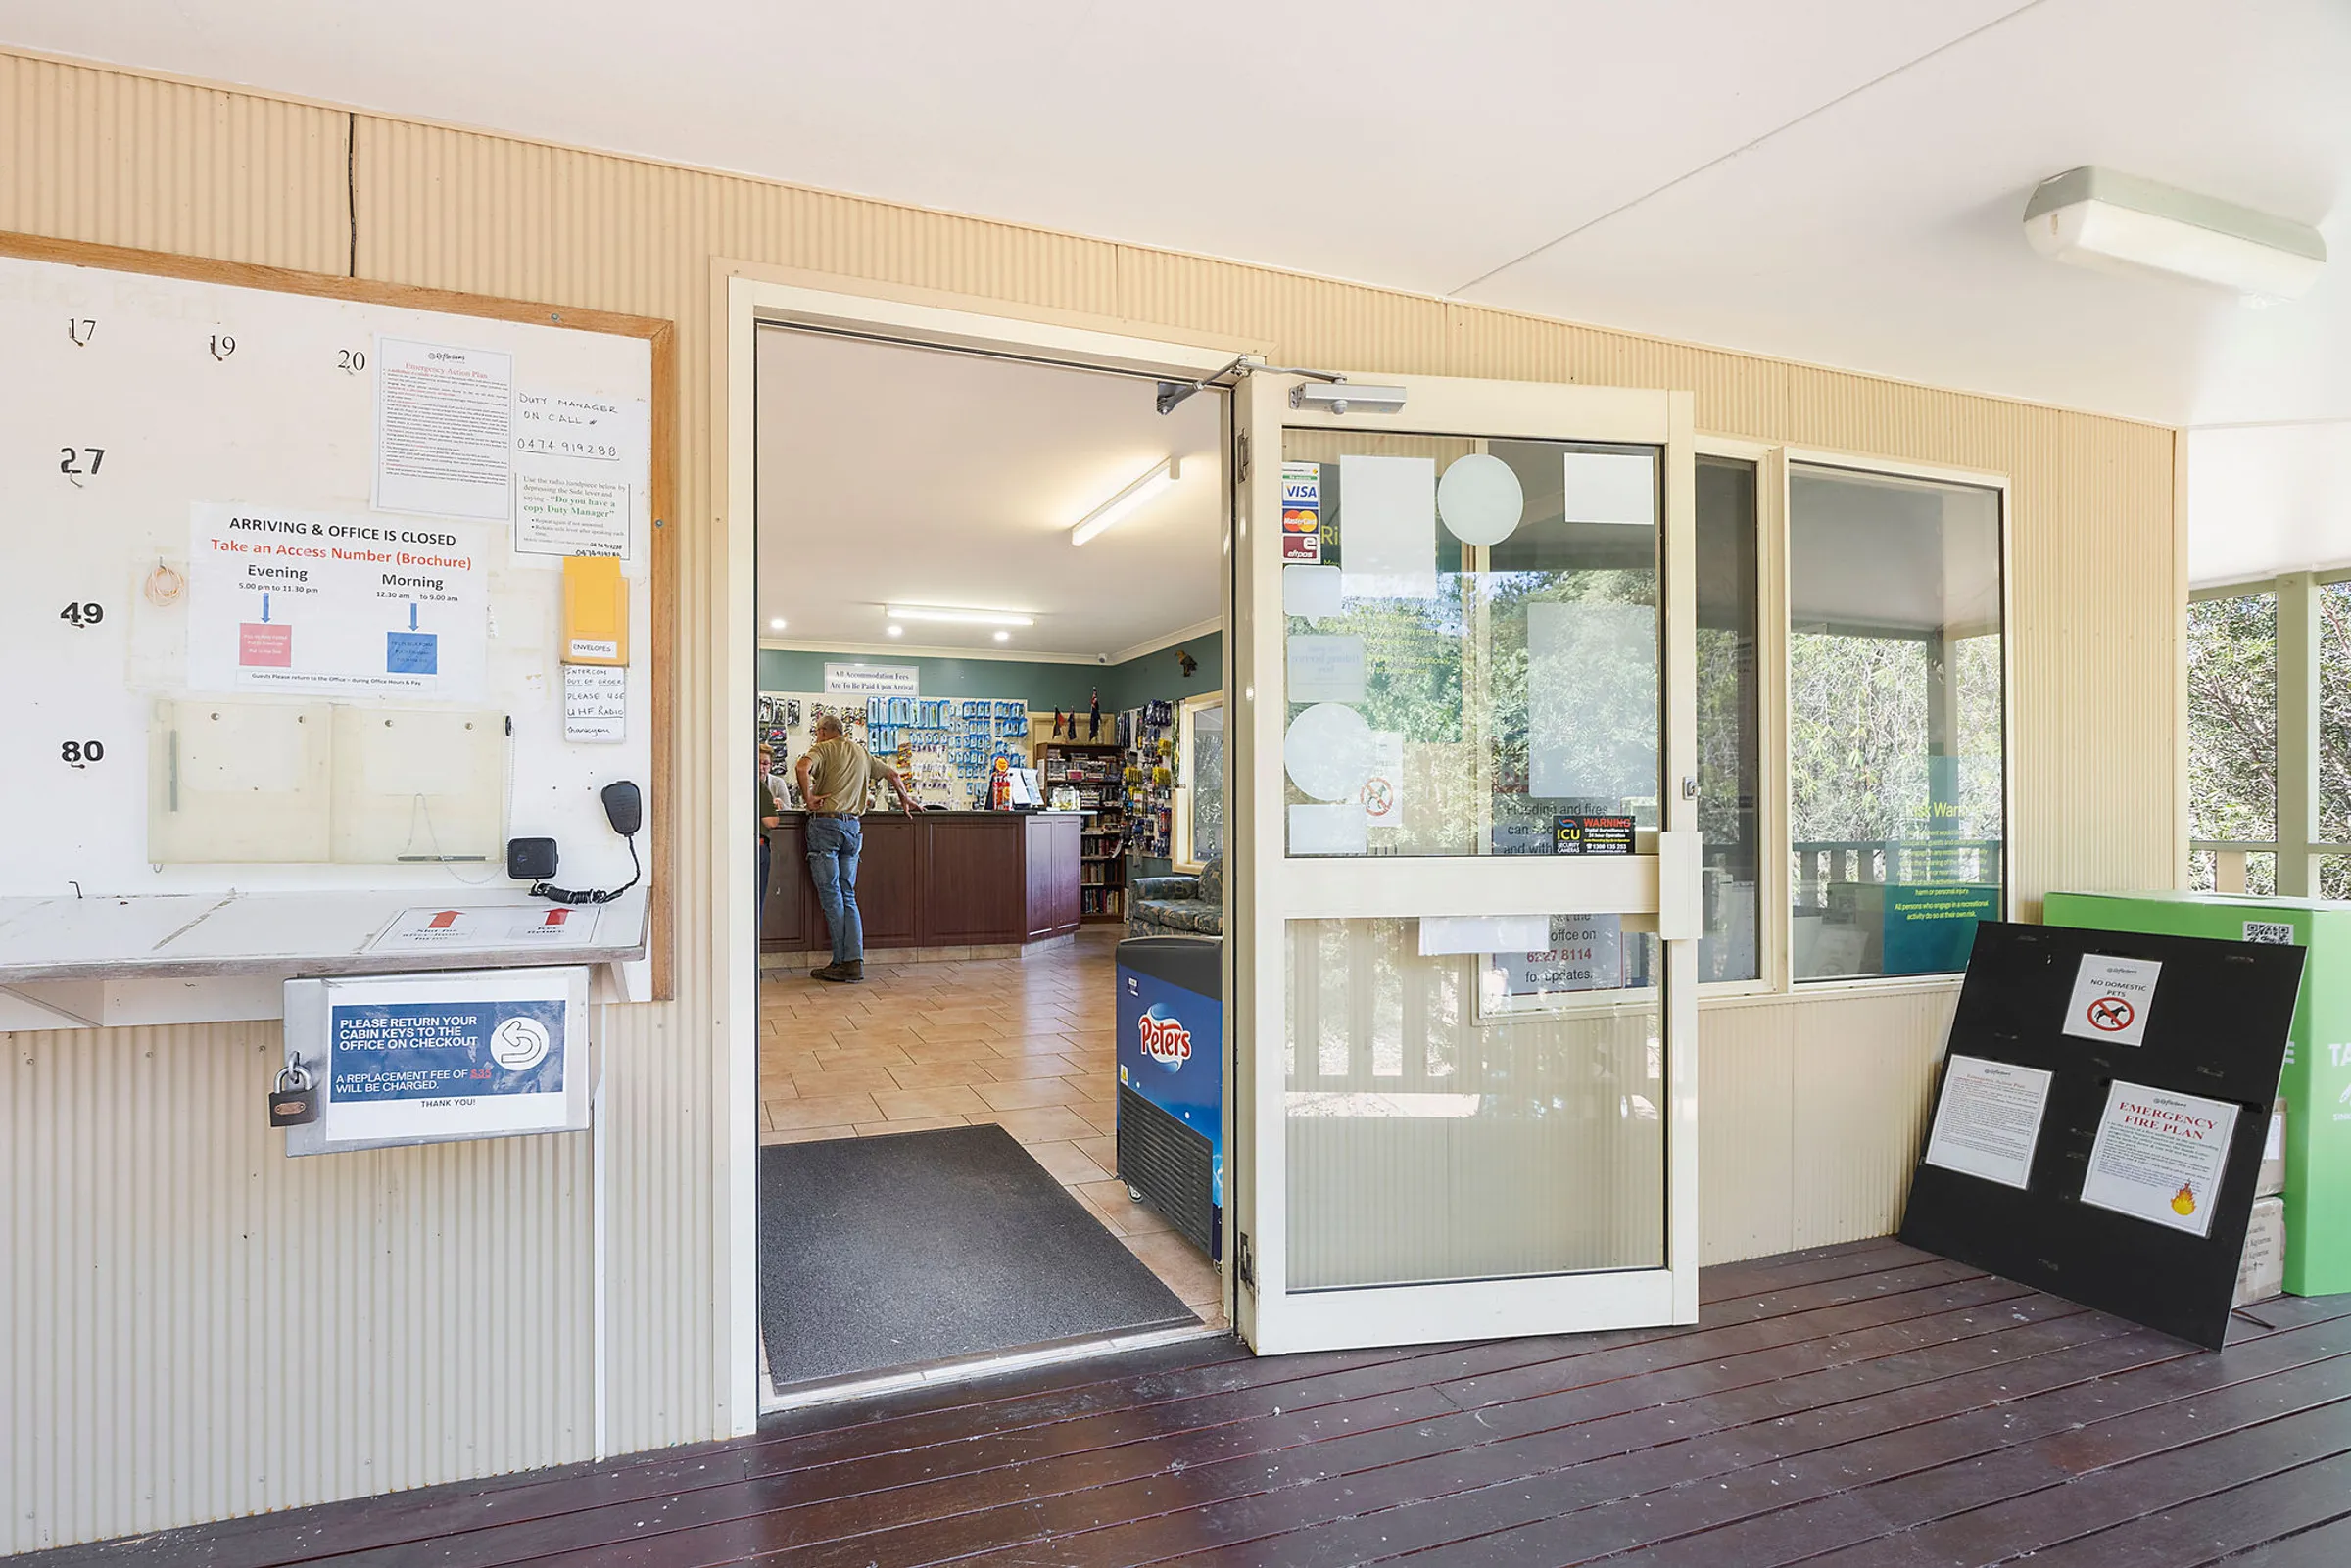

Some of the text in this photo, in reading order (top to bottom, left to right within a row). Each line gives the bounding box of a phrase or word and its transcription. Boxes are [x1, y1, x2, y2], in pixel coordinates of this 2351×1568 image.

[70, 318, 96, 341] 17
[210, 335, 236, 356] 19
[338, 350, 364, 370] 20
[405, 363, 445, 374] Emergency
[447, 367, 470, 377] Action
[557, 399, 618, 413] MANAGER
[523, 411, 582, 424] ON CALL
[60, 447, 106, 475] 27
[523, 484, 556, 494] depressing
[1285, 485, 1317, 498] VISA
[570, 498, 586, 506] you
[588, 498, 608, 507] have
[523, 504, 545, 514] copy
[547, 505, 568, 516] Duty
[229, 517, 456, 546] ARRIVING & OFFICE IS CLOSED
[1320, 525, 1341, 546] Ri
[211, 538, 472, 571] Take an Access Number (Brochure)
[1287, 549, 1313, 558] eftpos
[248, 564, 309, 582] Evening
[381, 573, 444, 591] Morning
[283, 585, 304, 594] 11.30
[376, 591, 397, 599] 12.30
[60, 601, 105, 625] 49
[60, 740, 105, 763] 80
[1559, 803, 1581, 815] and
[1585, 803, 1607, 815] fires
[1508, 825, 1528, 835] can
[1583, 818, 1631, 828] WARNING
[1557, 829, 1580, 840] ICU
[1504, 843, 1528, 854] and
[1582, 930, 1596, 940] on
[1527, 948, 1592, 963] 6227 8114
[1526, 971, 1540, 982] fo
[2105, 981, 2147, 991] DOMESTIC
[340, 1016, 477, 1029] PLEASE RETURN YOUR
[340, 1026, 461, 1040] CABIN KEYS TO THE
[1139, 1016, 1191, 1058] Peters
[339, 1036, 478, 1051] OFFICE ON CHECKOUT
[336, 1074, 345, 1084] A
[346, 1071, 428, 1083] REPLACEMENT
[430, 1070, 451, 1080] FEE
[454, 1069, 468, 1079] OF
[336, 1080, 440, 1094] WILL BE CHARGED.
[2119, 1102, 2218, 1129] EMERGENCY
[2125, 1116, 2205, 1140] FIRE PLAN
